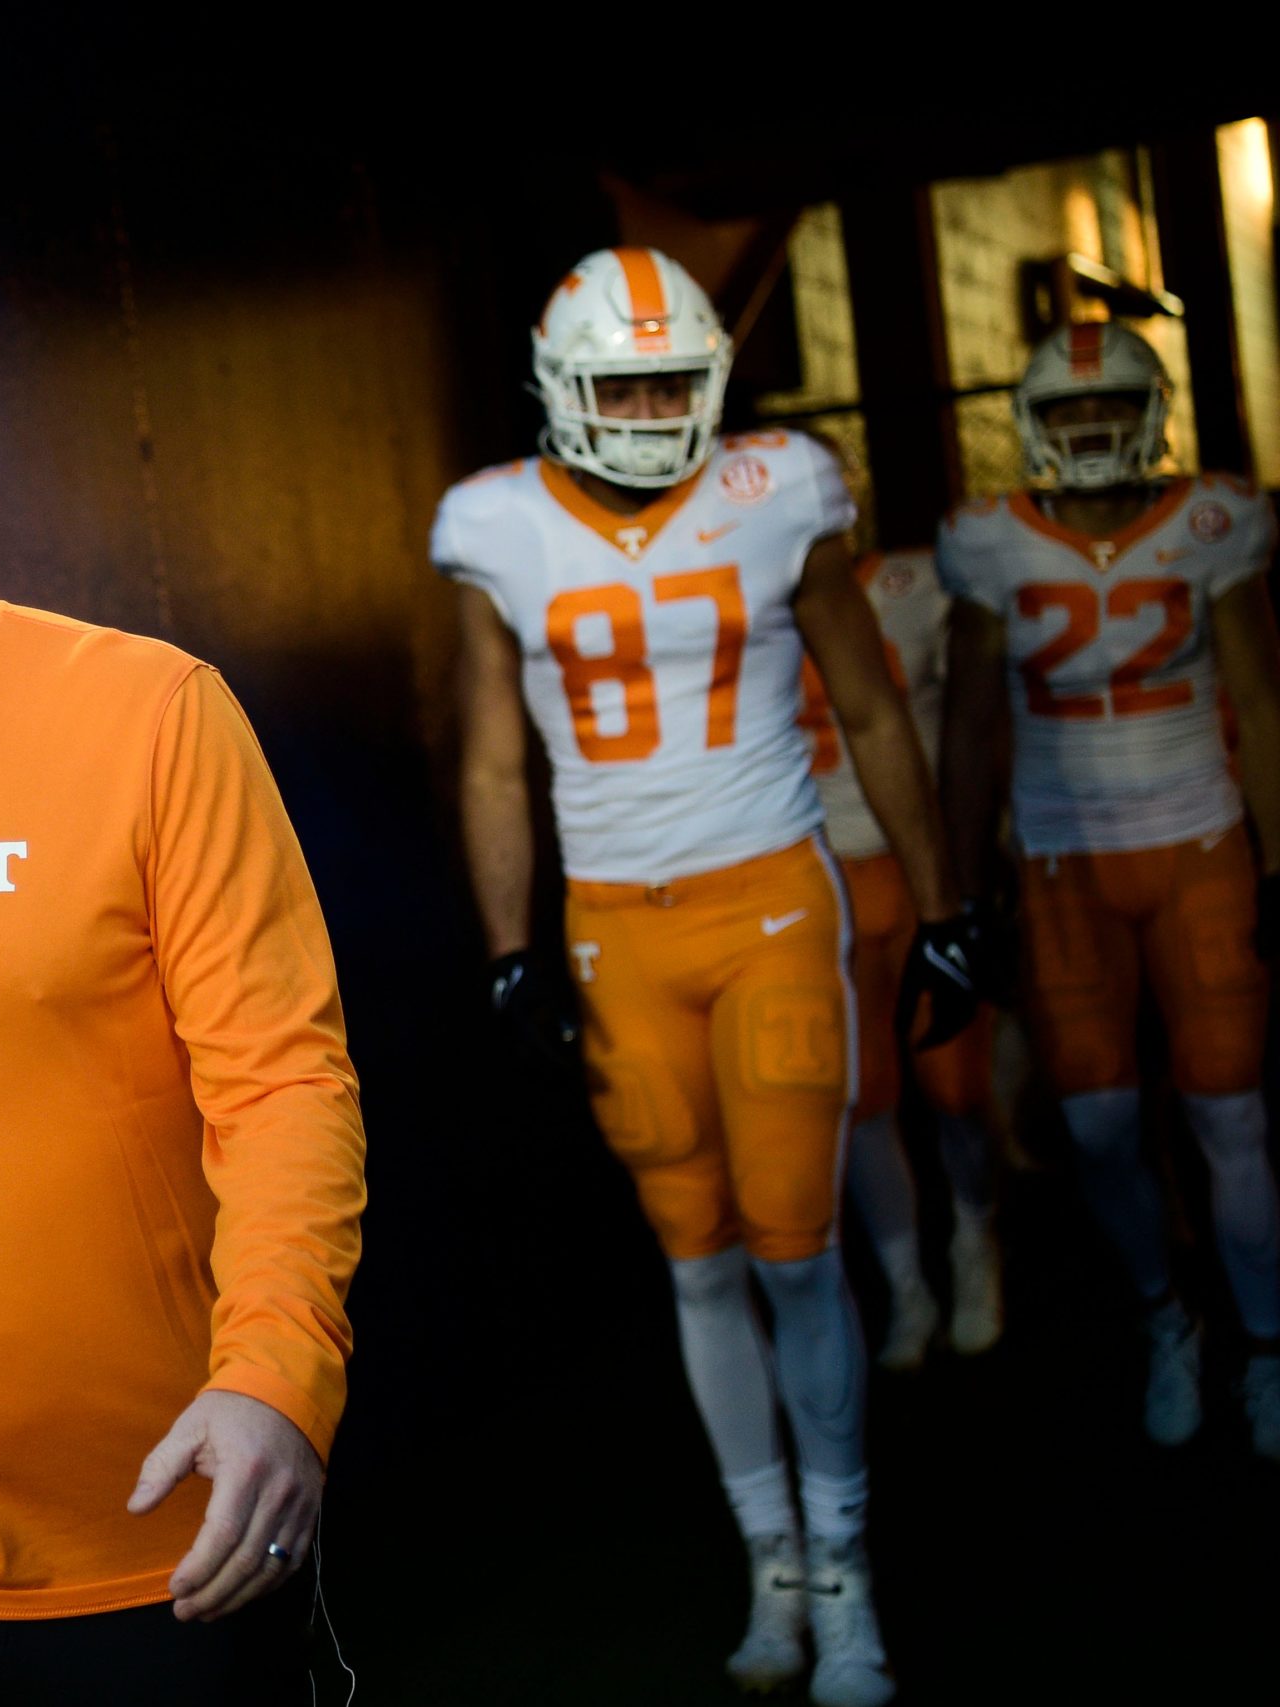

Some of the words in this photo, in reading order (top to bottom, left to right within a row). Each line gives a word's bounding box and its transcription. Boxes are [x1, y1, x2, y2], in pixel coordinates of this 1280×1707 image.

[615, 527, 647, 562] T
[546, 565, 747, 761] 87
[1018, 581, 1194, 717] 22
[570, 940, 602, 983] T
